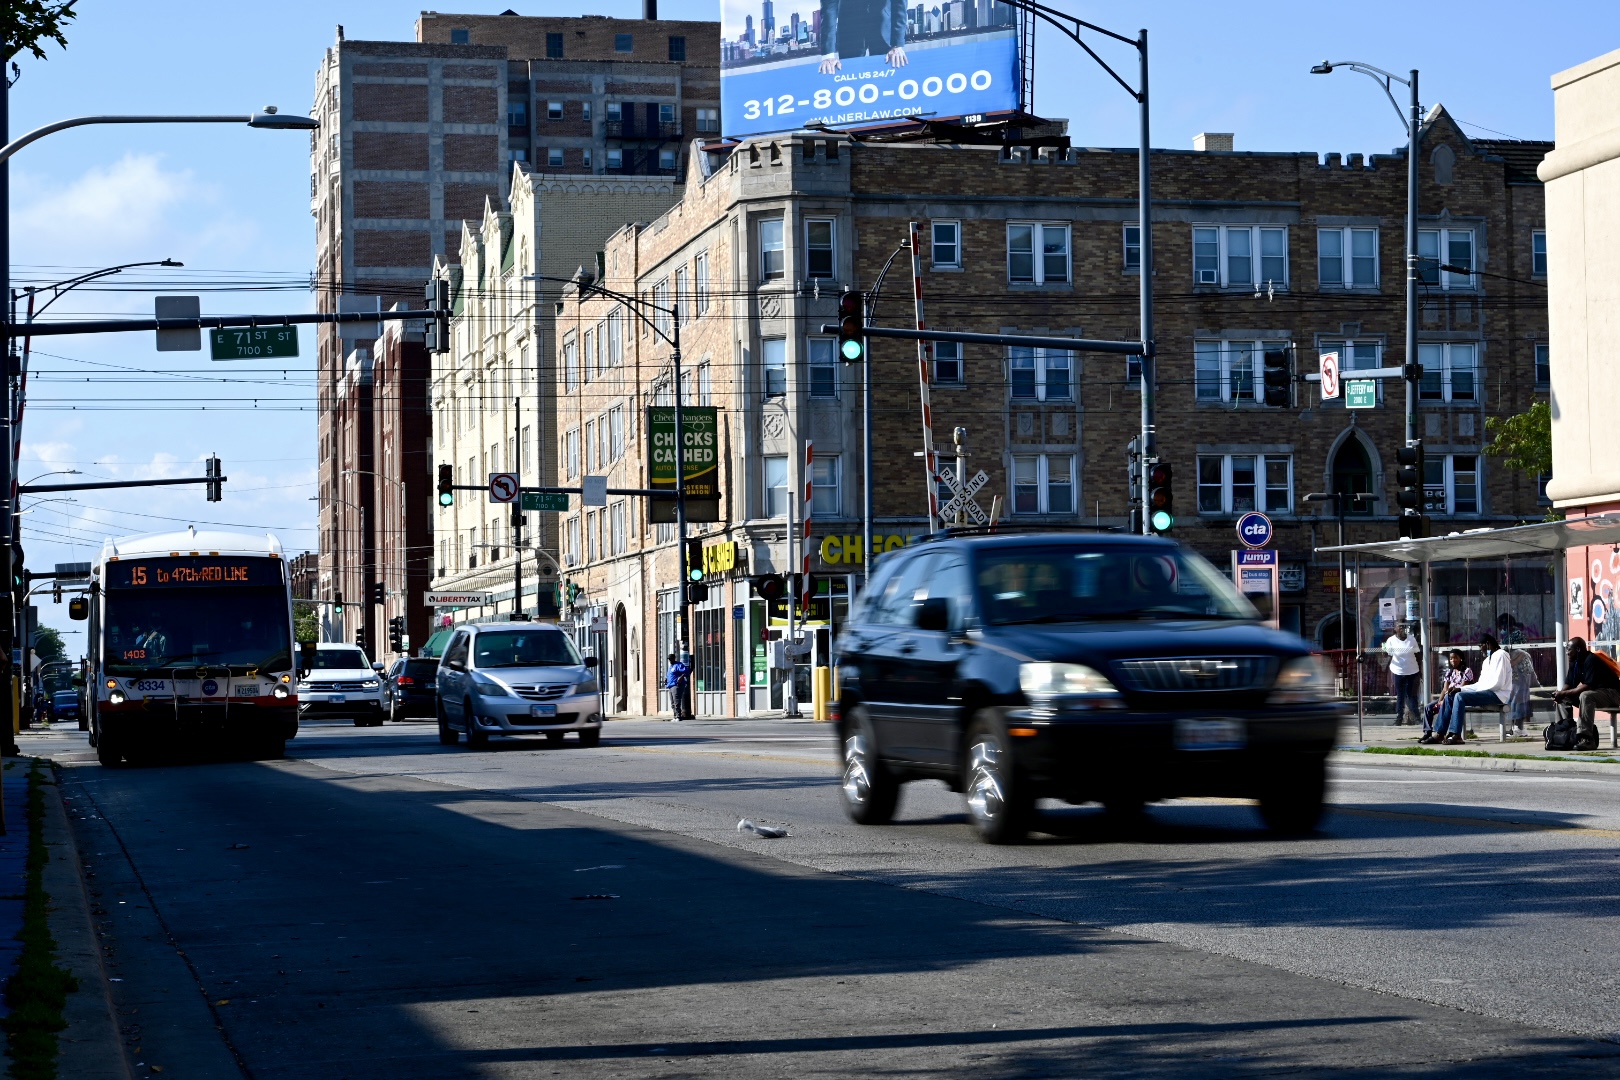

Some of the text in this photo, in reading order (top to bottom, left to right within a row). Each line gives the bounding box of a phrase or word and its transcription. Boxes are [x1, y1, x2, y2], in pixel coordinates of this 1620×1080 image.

[834, 69, 895, 82] CALL US 24/7
[743, 70, 992, 120] 312-800-0000
[964, 115, 982, 123] 1139
[218, 335, 224, 343] E
[278, 332, 291, 340] ST
[236, 346, 273, 355] 7100 S
[1350, 384, 1367, 395] JEFFERY
[654, 432, 713, 446] CHCKS
[942, 470, 958, 492] RAIL
[966, 499, 985, 522] ROAD
[944, 474, 985, 518] CROSSING
[1245, 524, 1266, 535] cta
[1242, 553, 1270, 563] jump
[132, 567, 146, 585] 15
[157, 568, 168, 582] to
[224, 566, 248, 580] LINE
[124, 650, 145, 659] 1403
[138, 681, 164, 691] 8334
